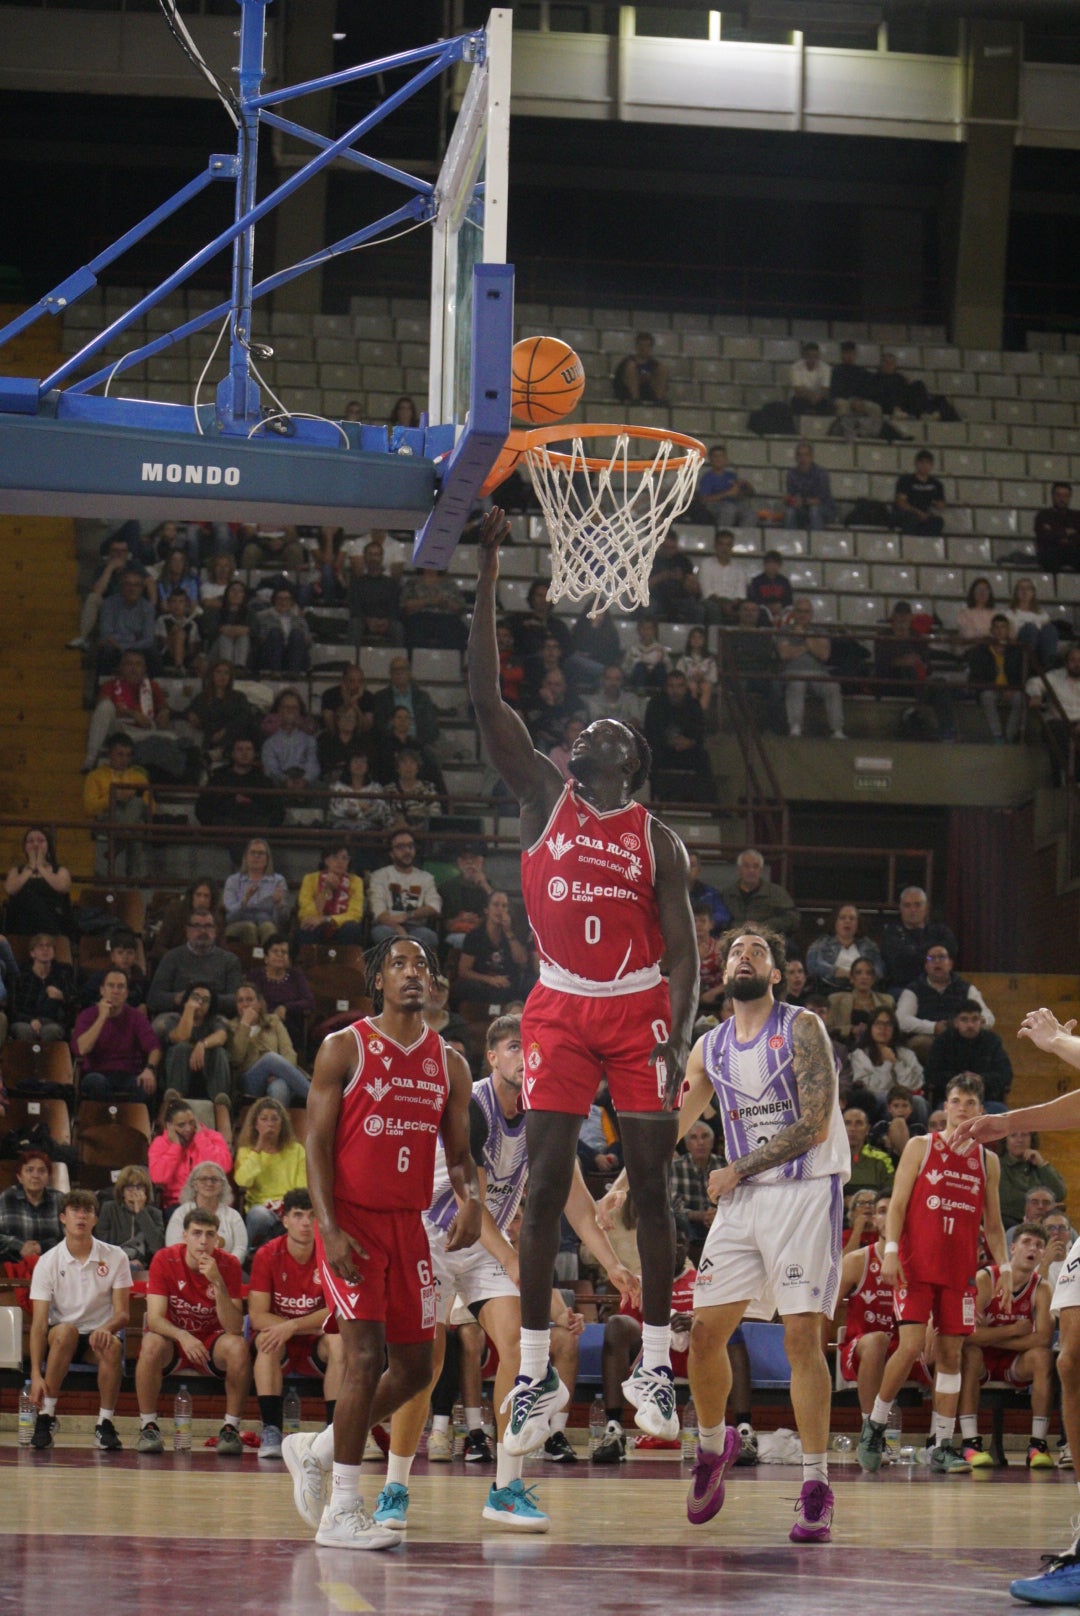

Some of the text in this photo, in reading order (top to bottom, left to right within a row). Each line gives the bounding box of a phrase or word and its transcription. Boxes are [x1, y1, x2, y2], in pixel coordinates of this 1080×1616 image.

[142, 462, 240, 486] MONDO
[575, 834, 604, 850] CAJA
[606, 843, 643, 868] RURAL
[572, 894, 593, 902] LEÓN
[585, 915, 601, 945] 0
[651, 1019, 669, 1044] 0
[392, 1077, 445, 1094] CAJA RURAL
[739, 1099, 793, 1118] PROINBENI
[386, 1118, 438, 1133] E.Leclerc
[397, 1146, 411, 1173] 6
[416, 1259, 431, 1286] 6
